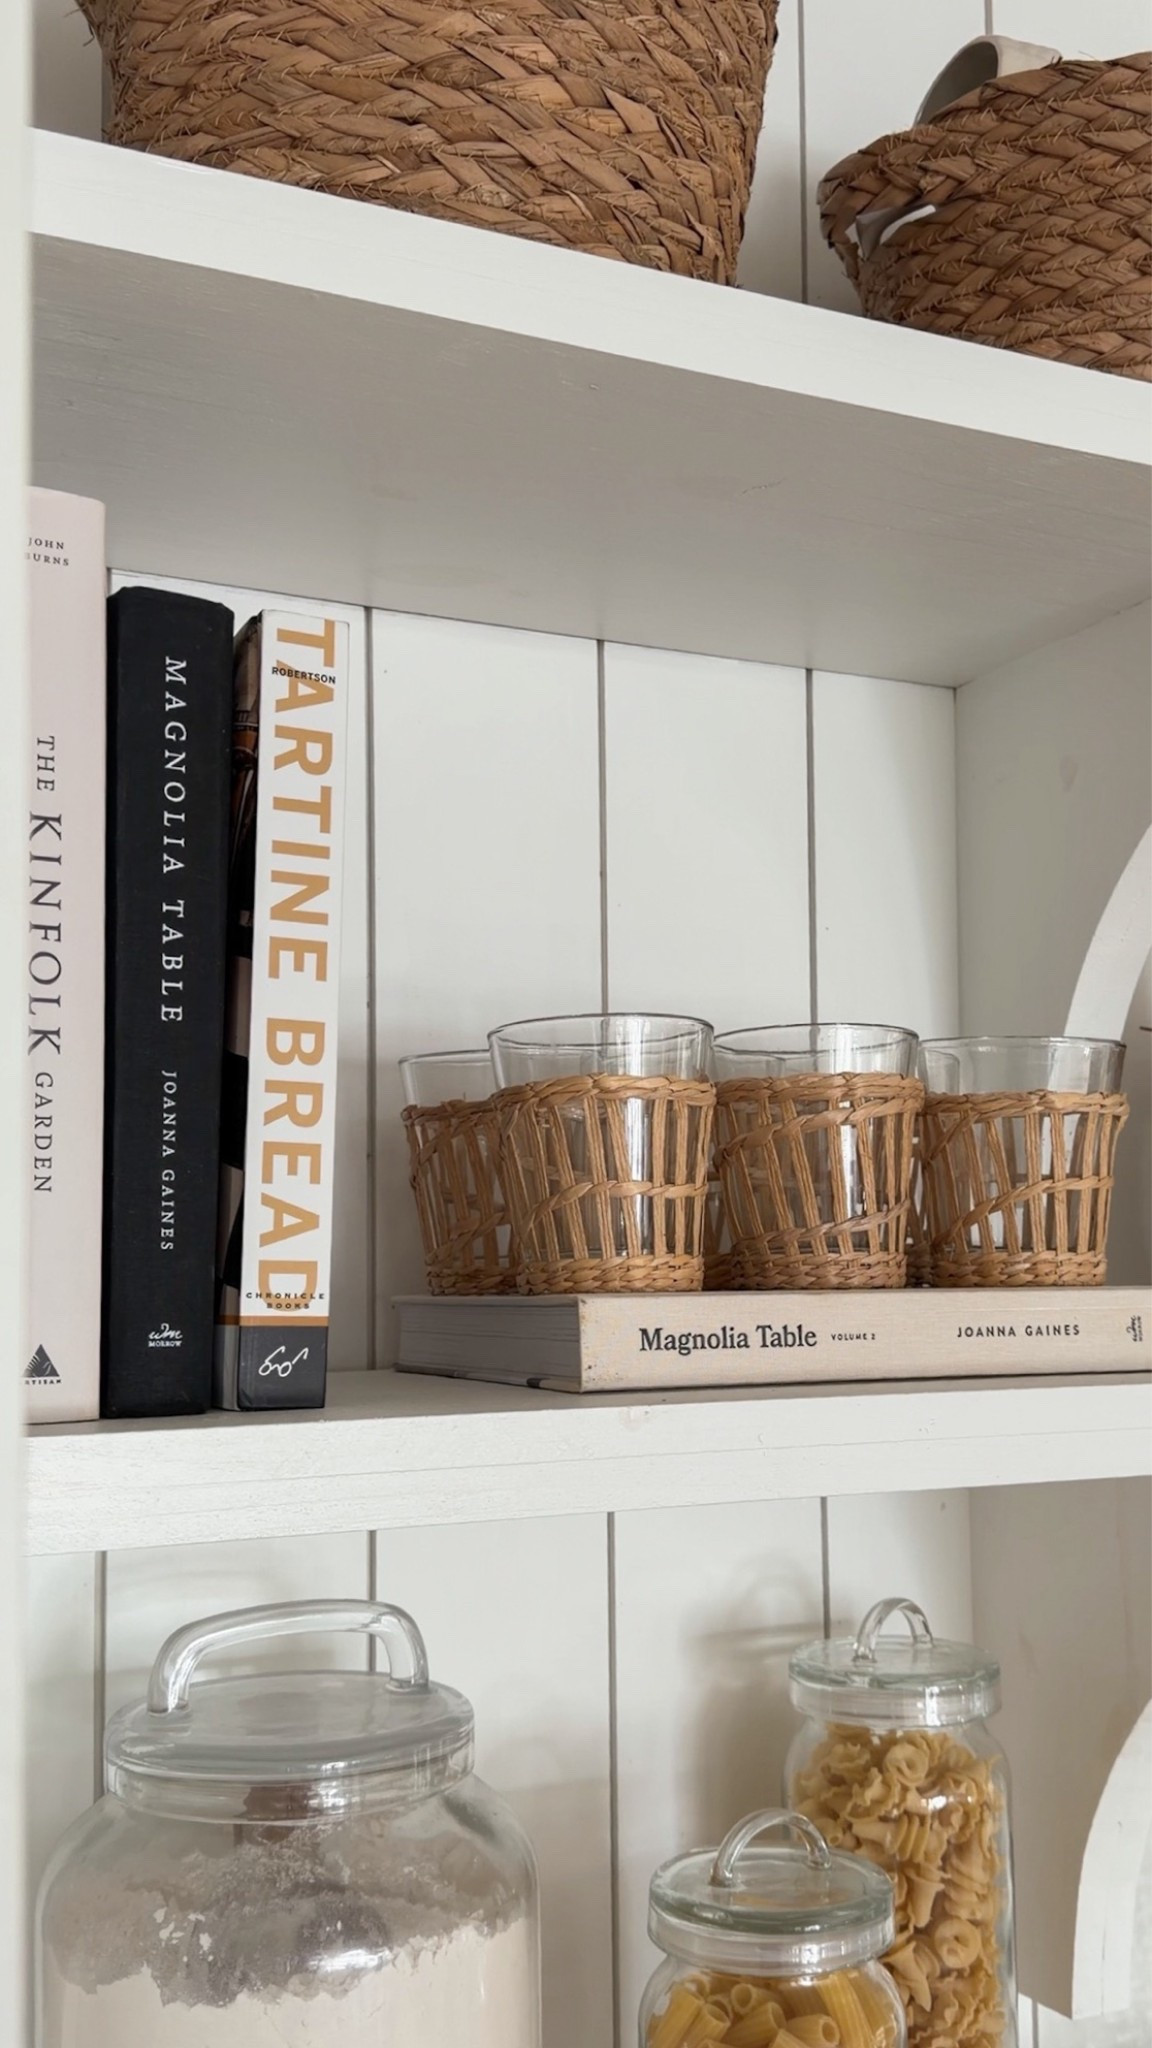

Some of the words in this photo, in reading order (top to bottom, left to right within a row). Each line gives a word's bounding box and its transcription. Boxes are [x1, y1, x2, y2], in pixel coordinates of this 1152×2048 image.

[29, 537, 64, 550] JOHN
[271, 666, 336, 684] ROBERTSON
[36, 735, 56, 792] THE
[162, 655, 188, 875] MAGNOLIA
[268, 619, 336, 983] TARTINE
[28, 811, 62, 1056] KINFOLK
[160, 898, 185, 1022] TABLE
[33, 1071, 54, 1193] GARDEN
[161, 1070, 178, 1159] JOANNA
[257, 1016, 326, 1312] BREAD
[160, 1169, 176, 1251] GAINES
[245, 1292, 325, 1300] CHRONICLE
[266, 1302, 310, 1310] BOOKS
[956, 1325, 1017, 1338] JOANNA
[1024, 1323, 1081, 1337] GAINES
[638, 1325, 751, 1357] Magnolia
[755, 1323, 818, 1349] Table
[830, 1332, 868, 1342] VOLUME
[870, 1332, 876, 1341] 2
